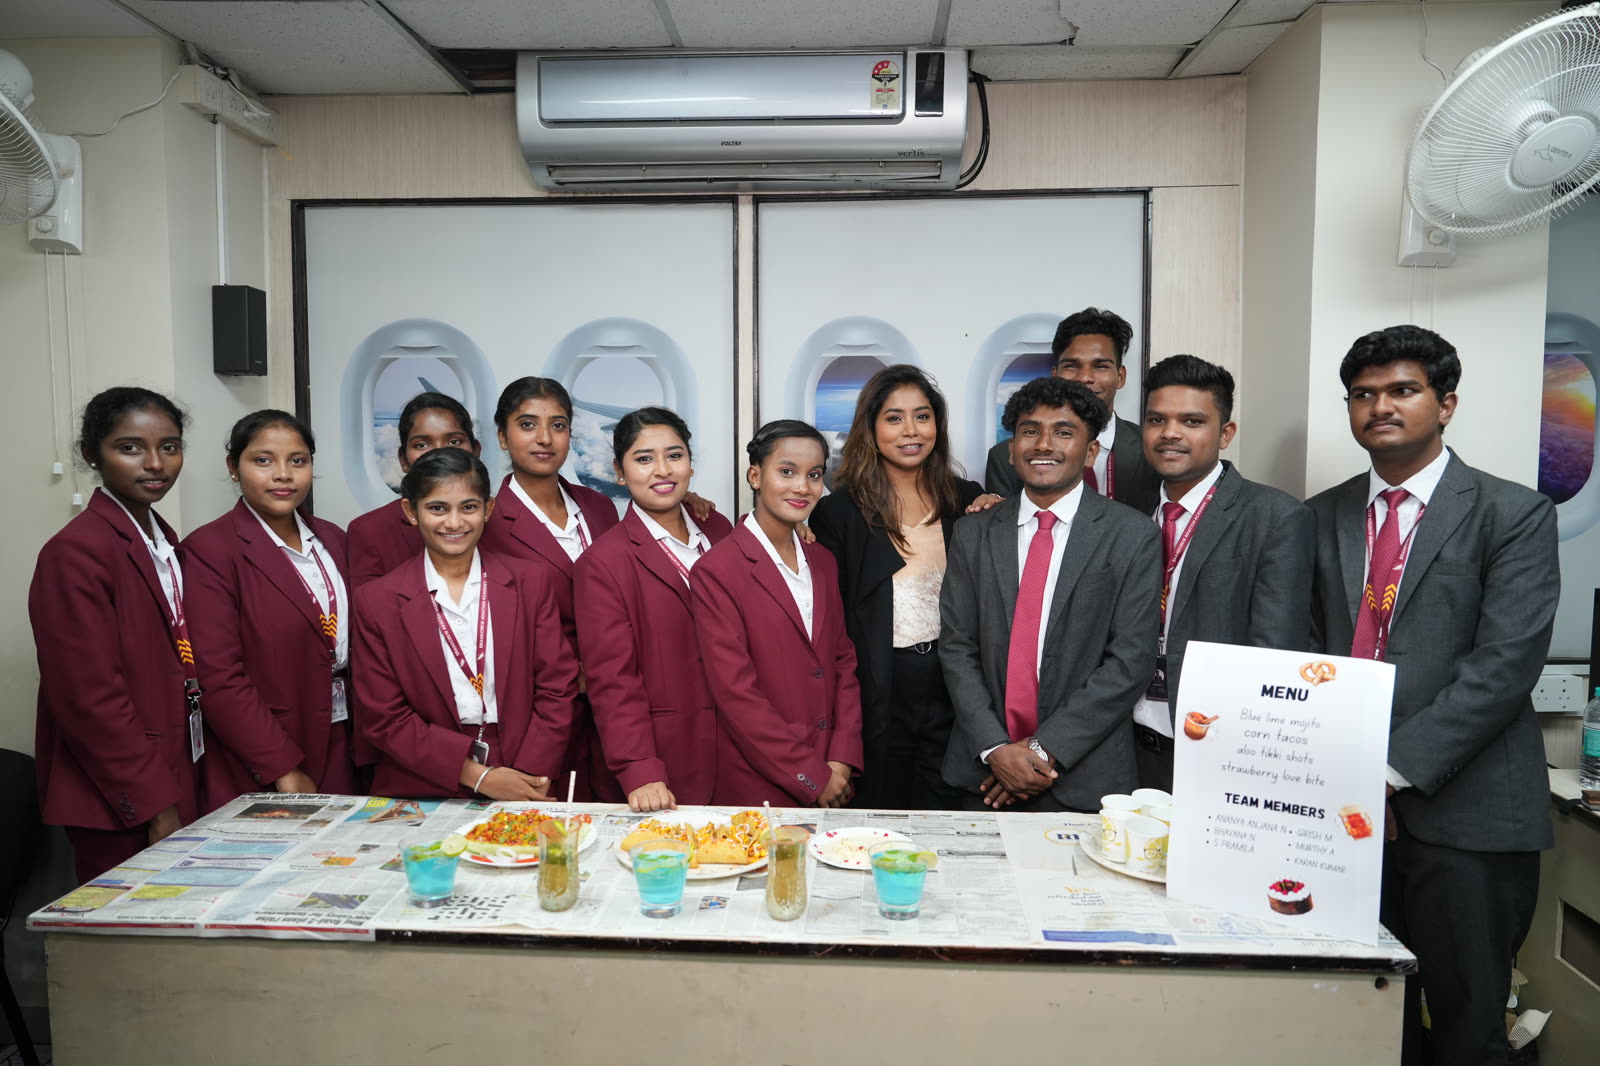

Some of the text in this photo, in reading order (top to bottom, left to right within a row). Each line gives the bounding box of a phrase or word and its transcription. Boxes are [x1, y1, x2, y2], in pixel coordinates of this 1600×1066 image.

[1260, 684, 1310, 701] MENU
[1240, 708, 1321, 732] Blue lime mojito
[1244, 728, 1308, 745] corn tacos
[1237, 744, 1313, 764] aloo tikki shots
[1221, 761, 1326, 787] strawberry love bite
[366, 800, 389, 808] SUN
[1224, 792, 1326, 820] TEAM MEMBERS
[1215, 813, 1245, 826] ANANYA
[1280, 825, 1287, 834] N
[1249, 833, 1256, 841] N
[1324, 833, 1333, 842] M
[1328, 848, 1335, 856] A
